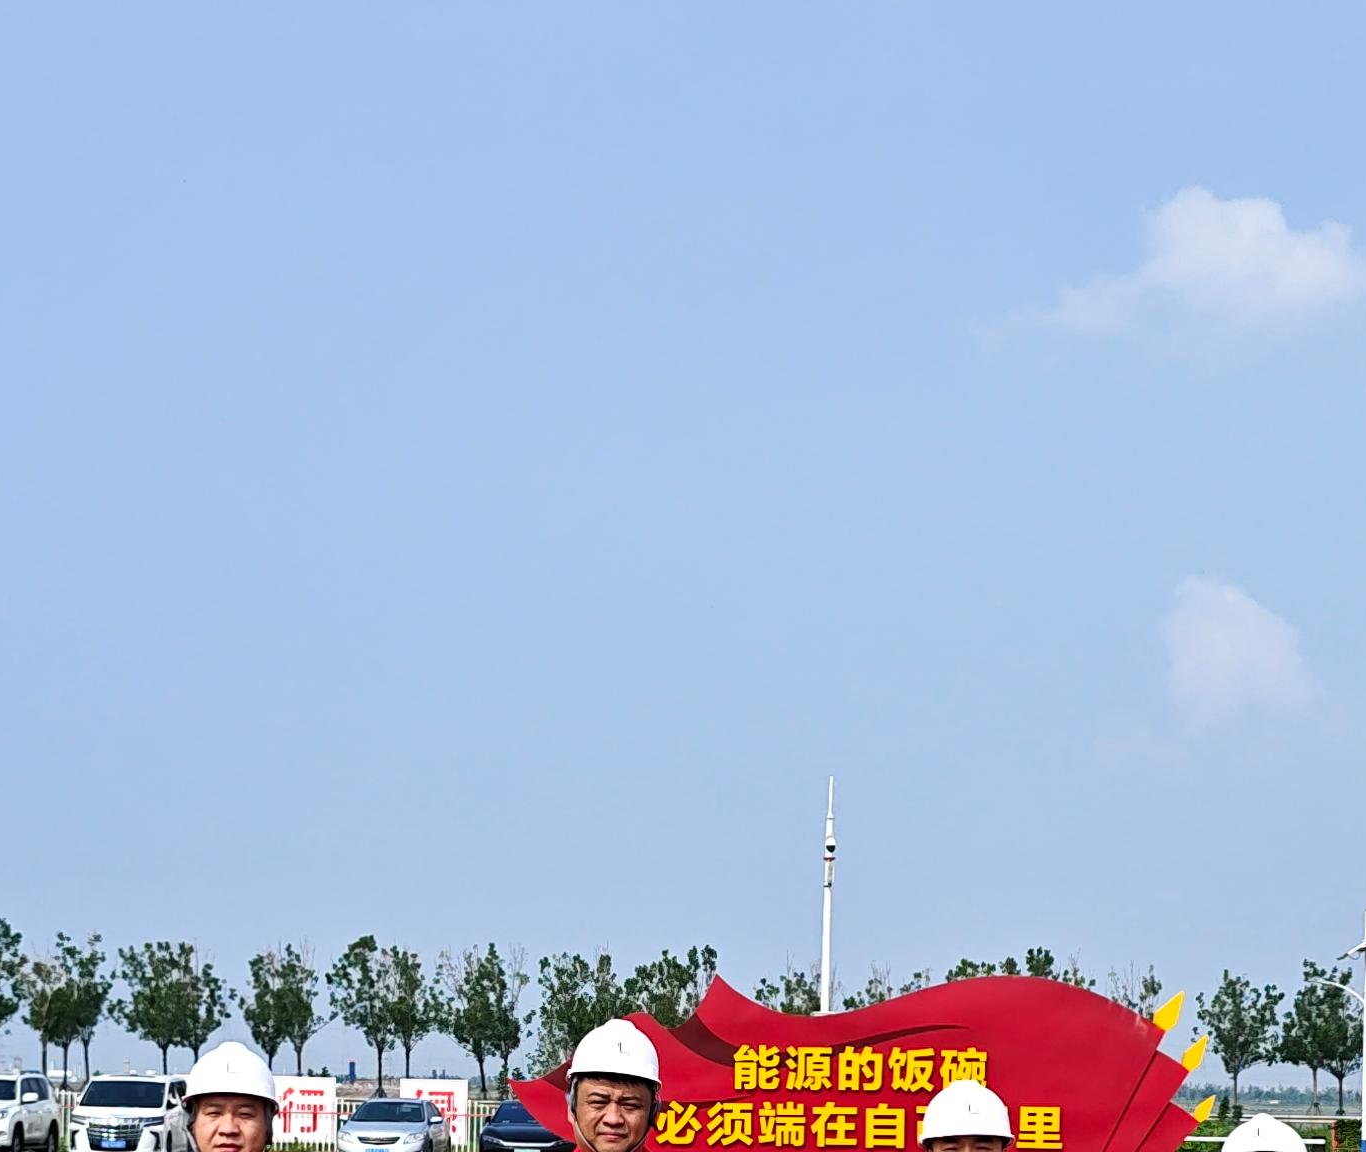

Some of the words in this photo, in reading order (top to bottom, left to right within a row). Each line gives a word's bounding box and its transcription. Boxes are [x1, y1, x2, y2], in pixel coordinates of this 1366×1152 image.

[733, 1044, 988, 1092] 能源的饭碗
[655, 1101, 1064, 1150] 必须端在自里
